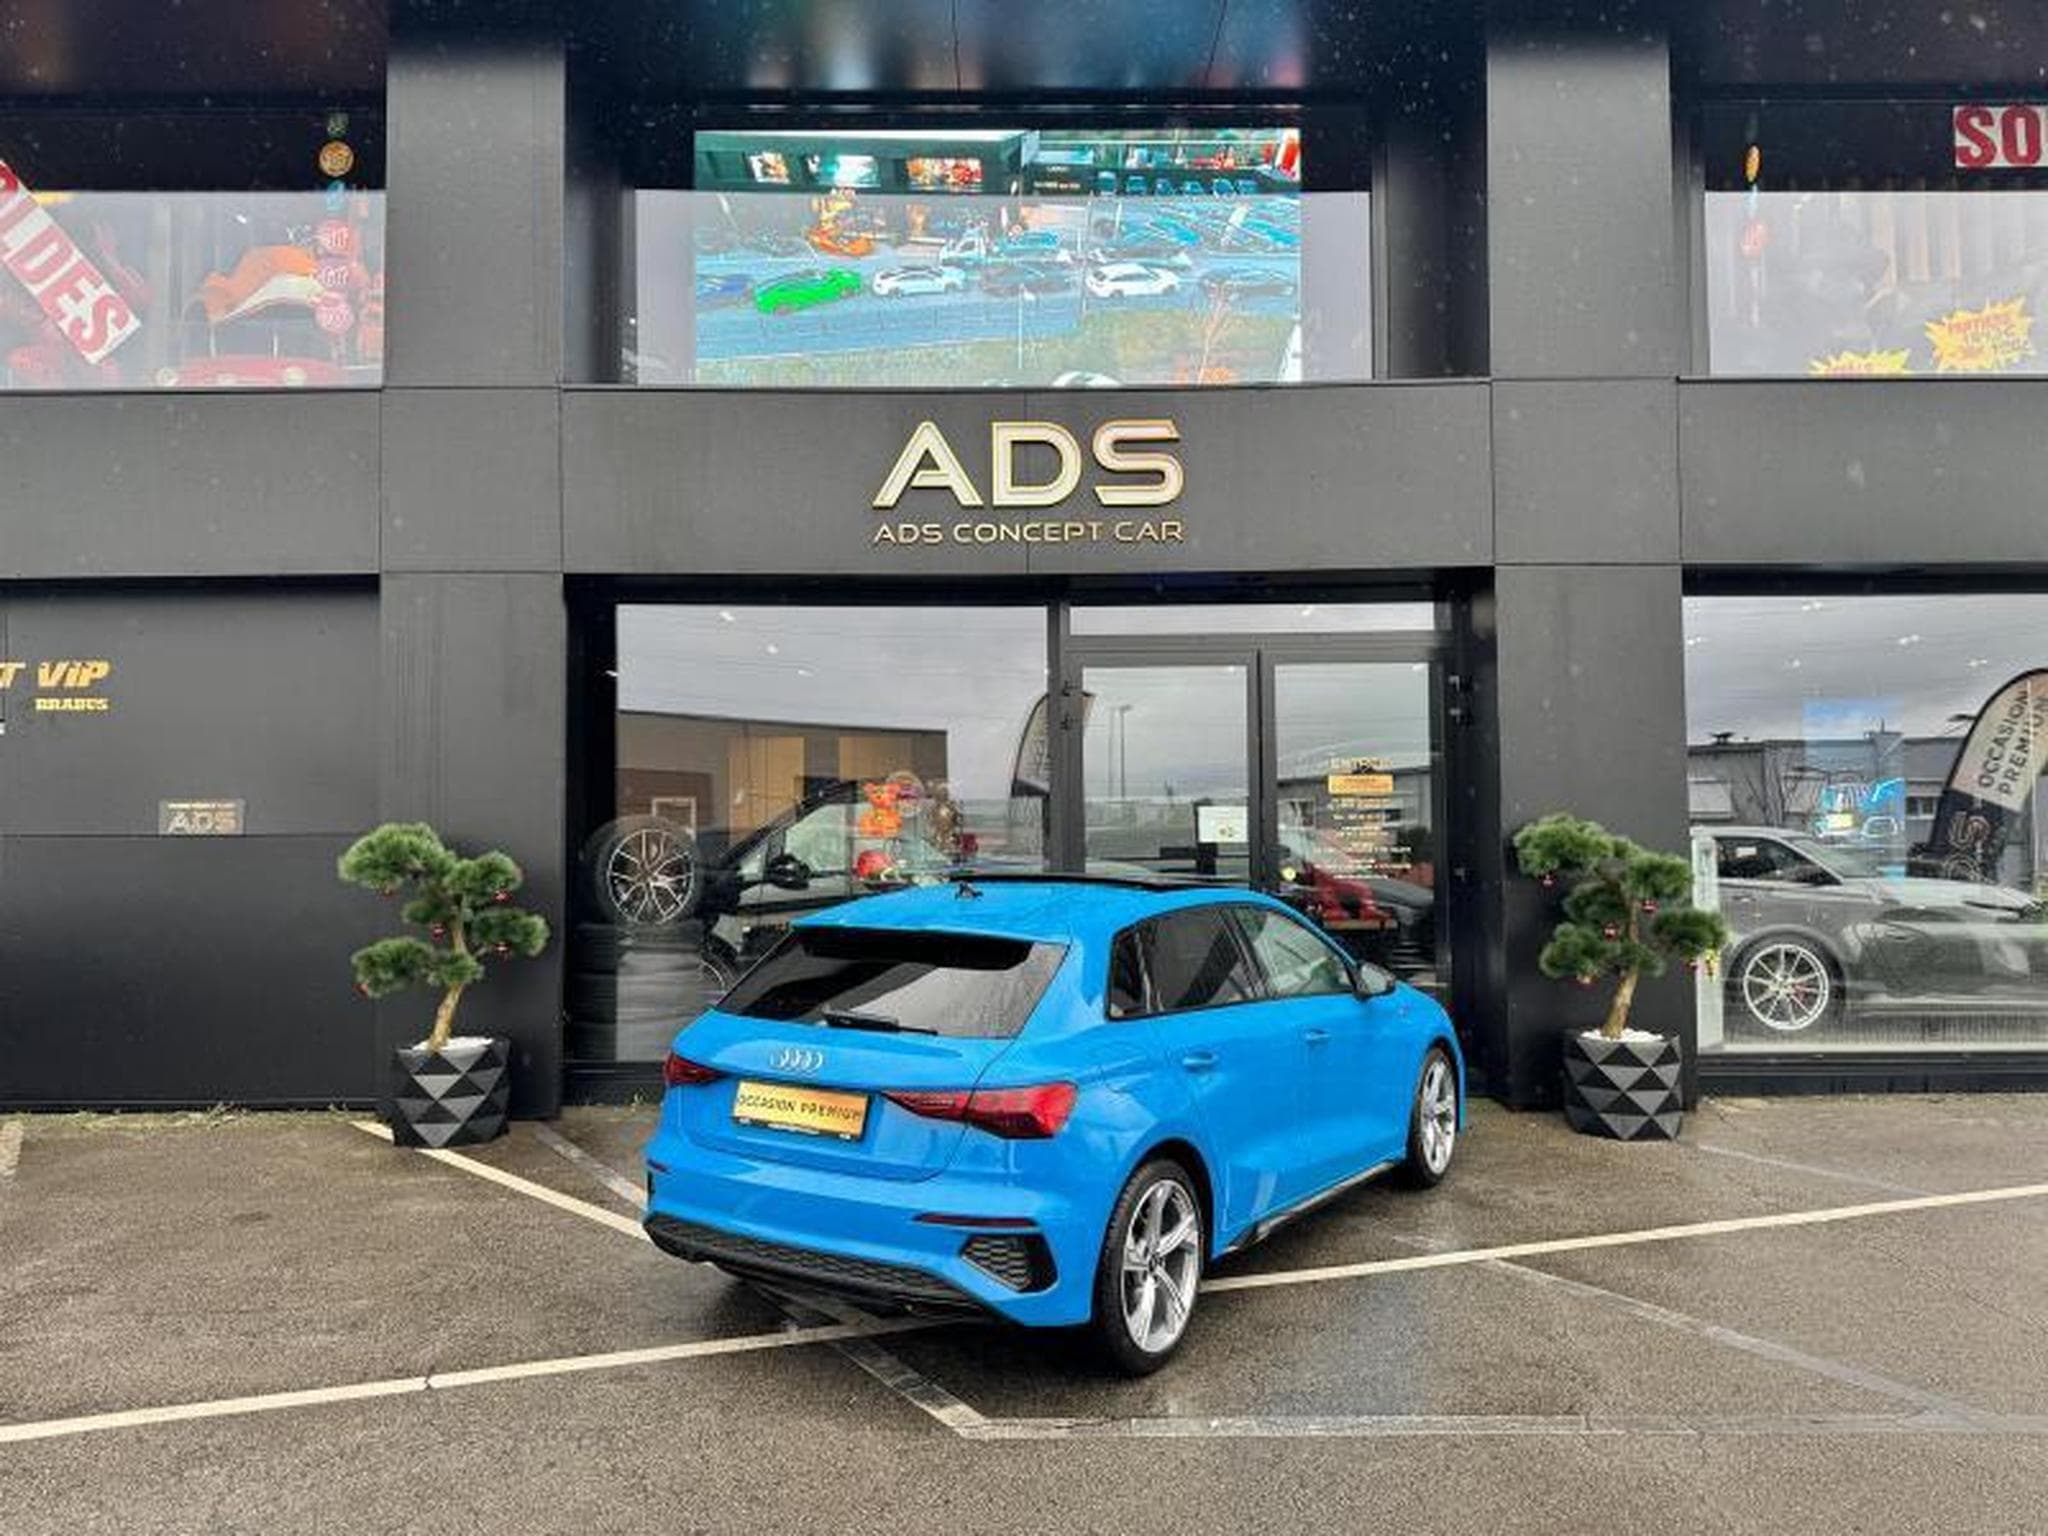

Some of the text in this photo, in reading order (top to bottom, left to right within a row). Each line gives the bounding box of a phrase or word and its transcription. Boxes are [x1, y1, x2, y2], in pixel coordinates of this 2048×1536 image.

[872, 419, 1185, 508] ADS
[873, 520, 1184, 544] ADS CONCEPT CAR
[1978, 689, 2029, 788] OCCASION
[739, 1094, 796, 1112] OCCASION
